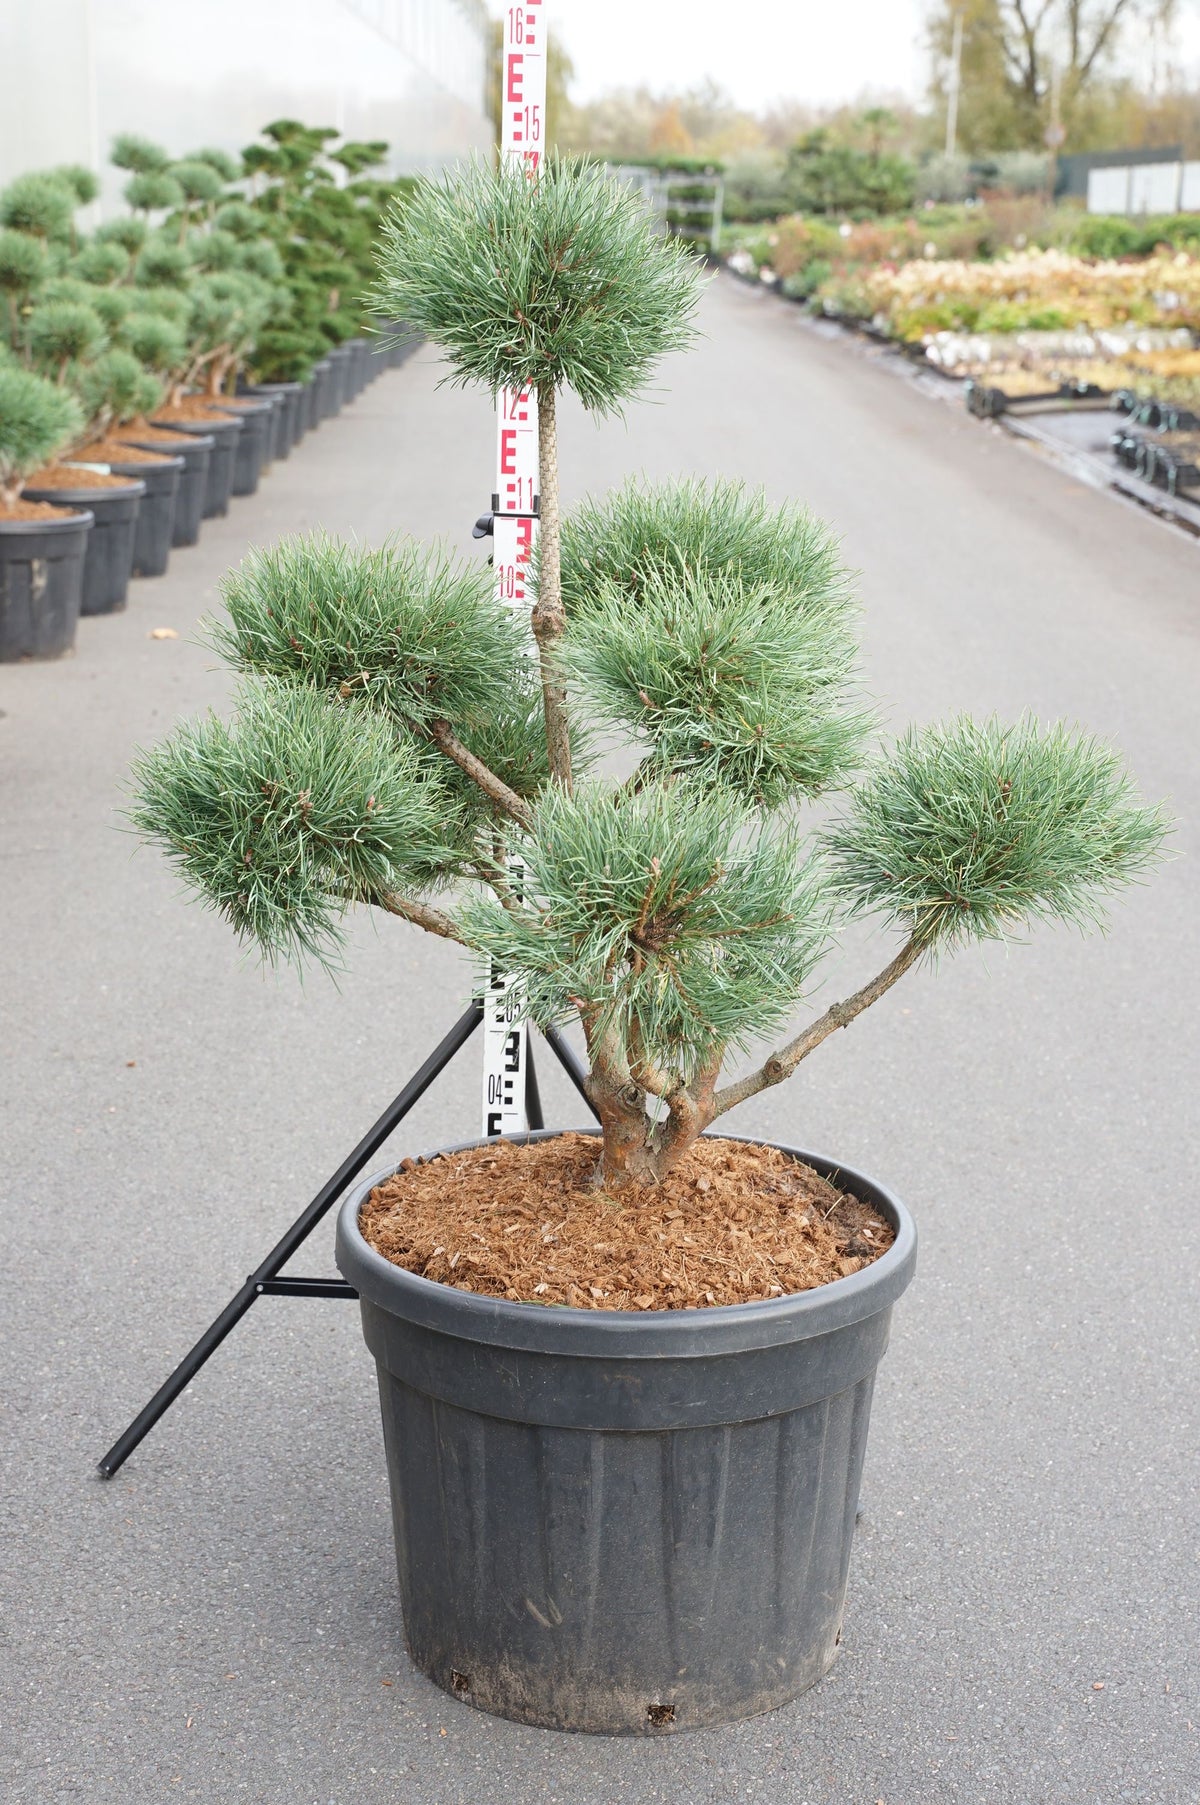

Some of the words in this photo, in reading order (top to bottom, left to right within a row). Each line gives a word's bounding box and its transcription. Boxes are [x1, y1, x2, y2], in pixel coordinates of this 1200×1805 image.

[508, 7, 523, 44] 16
[524, 105, 540, 141] 15
[502, 385, 517, 420] 12
[517, 477, 533, 510] 11
[499, 565, 514, 599] 10
[488, 1074, 503, 1105] 04
